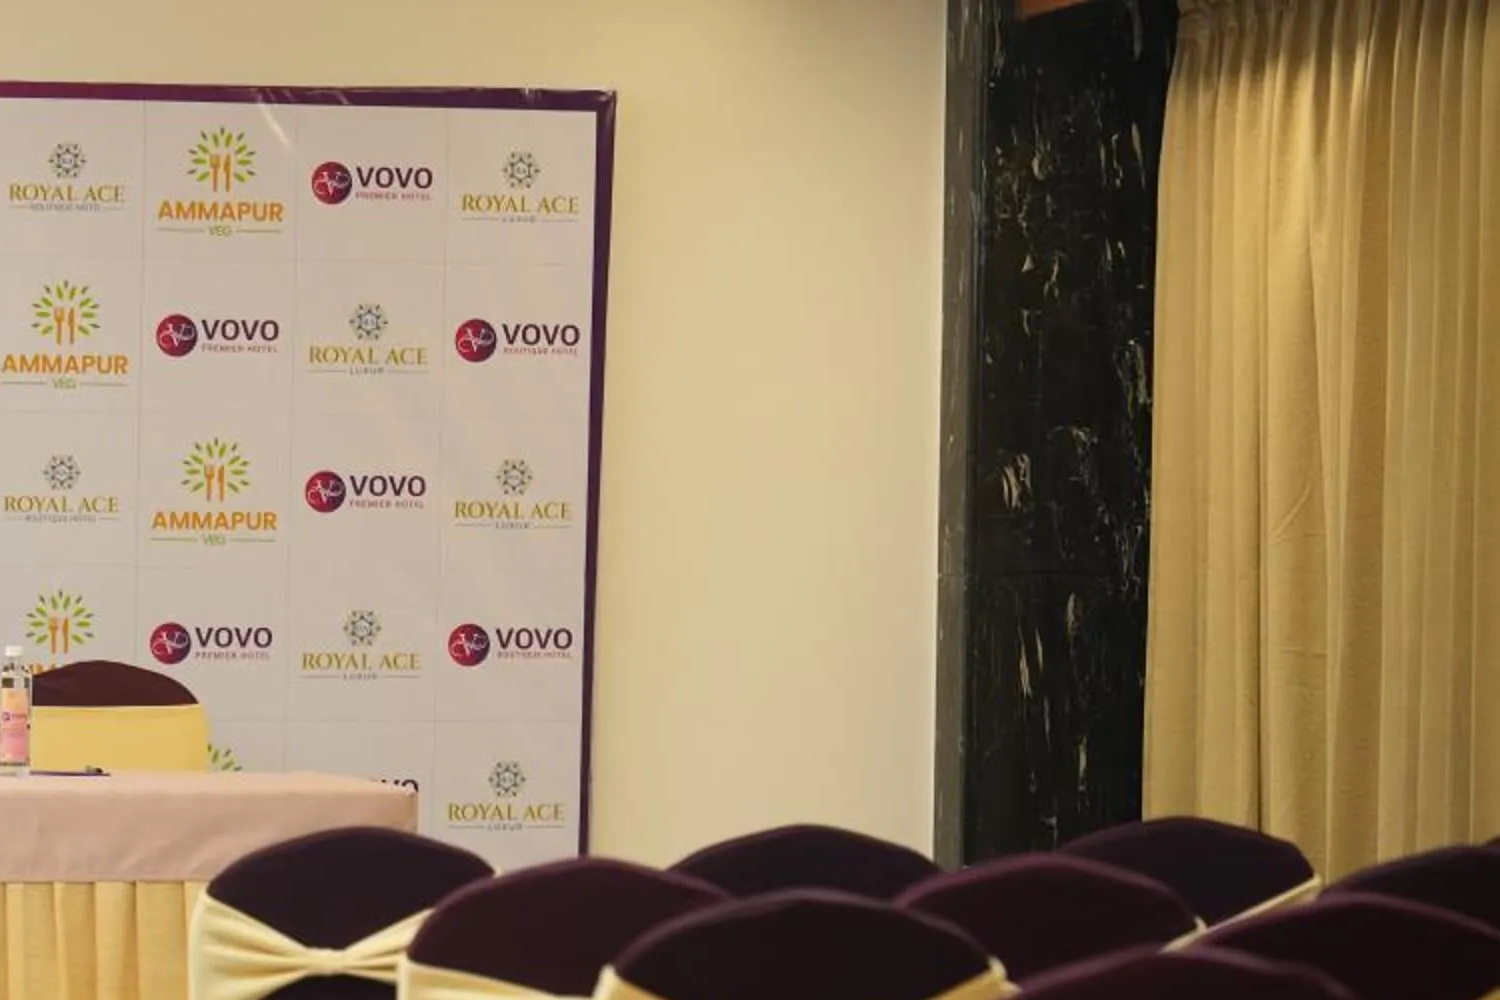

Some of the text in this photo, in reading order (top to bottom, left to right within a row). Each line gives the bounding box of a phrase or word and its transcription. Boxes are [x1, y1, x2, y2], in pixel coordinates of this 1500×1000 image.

[356, 167, 433, 190] VOVO
[9, 184, 125, 202] ROYAL ACE
[157, 200, 283, 223] AMMAPUR
[461, 195, 579, 214] ROYAL ACE
[208, 225, 232, 237] VEG
[200, 320, 279, 341] VOVO
[501, 324, 580, 346] VOVO
[1, 354, 128, 375] AMMAPUR
[308, 346, 428, 366] ROYAL ACE
[51, 377, 77, 390] VEG
[349, 475, 426, 497] VOVO
[4, 496, 119, 514] ROYAL ACE
[455, 501, 571, 520] ROYAL ACE
[151, 511, 277, 531] AMMAPUR
[202, 533, 227, 546] VEG
[194, 627, 272, 649] VOVO
[496, 628, 573, 650] VOVO
[302, 653, 421, 672] ROYAL ACE
[448, 803, 565, 822] ROYAL ACE
